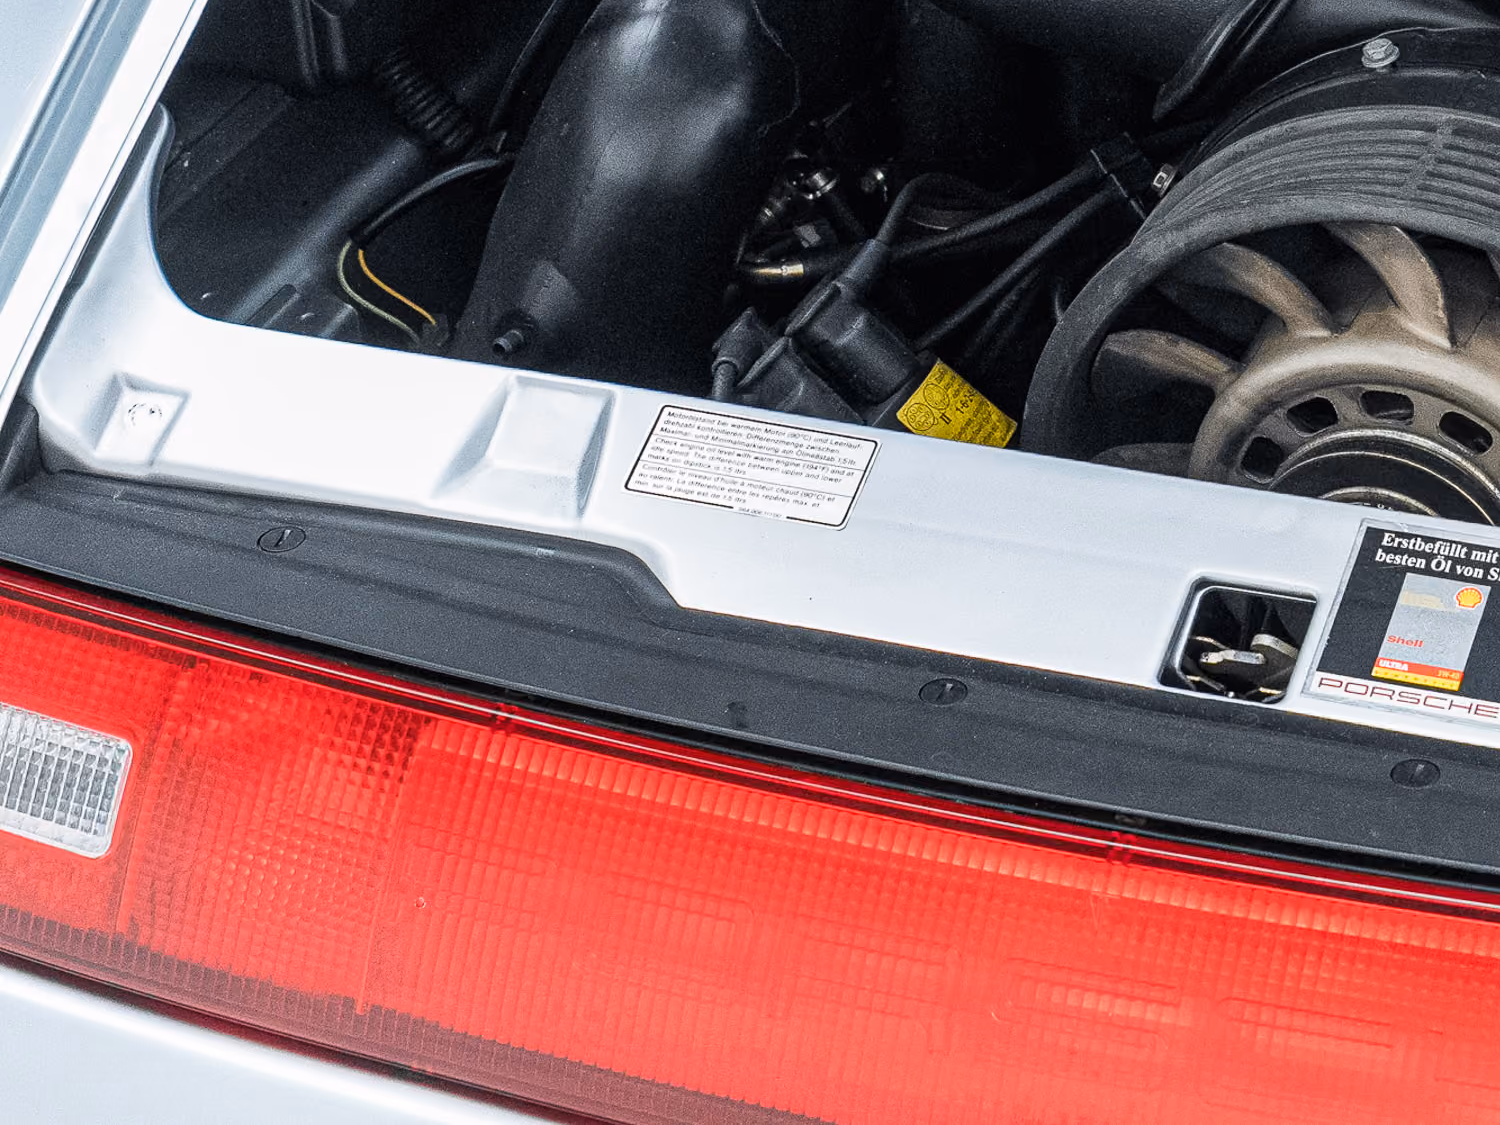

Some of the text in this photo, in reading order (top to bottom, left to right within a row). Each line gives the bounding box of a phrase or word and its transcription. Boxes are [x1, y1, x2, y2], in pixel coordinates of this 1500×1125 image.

[693, 432, 709, 440] und
[709, 435, 781, 453] Minimalmarkierung
[744, 433, 804, 449] Differenzmenge
[805, 443, 840, 454] zwischen
[763, 427, 786, 436] Motor
[812, 436, 829, 444] und
[646, 453, 670, 461] marks
[654, 437, 678, 446] Check
[678, 441, 705, 452] engine
[716, 448, 735, 456] level
[735, 451, 752, 459] with
[752, 454, 775, 463] warm
[774, 458, 800, 468] engine
[707, 455, 746, 466] difference
[747, 461, 779, 472] between
[780, 467, 804, 477] upper
[804, 471, 820, 479] and
[820, 474, 843, 483] lower
[726, 487, 748, 495] entre
[746, 482, 773, 491] moteur
[775, 487, 799, 496] chaud
[1381, 532, 1469, 560] Erstbefüllt
[1471, 549, 1500, 563] mit
[1375, 548, 1426, 570] besten
[1430, 554, 1452, 574] Öl
[1456, 564, 1484, 579] von
[1387, 634, 1424, 648] Shell
[1378, 658, 1409, 671] ULTRA
[1317, 676, 1500, 719] PORSCHE
